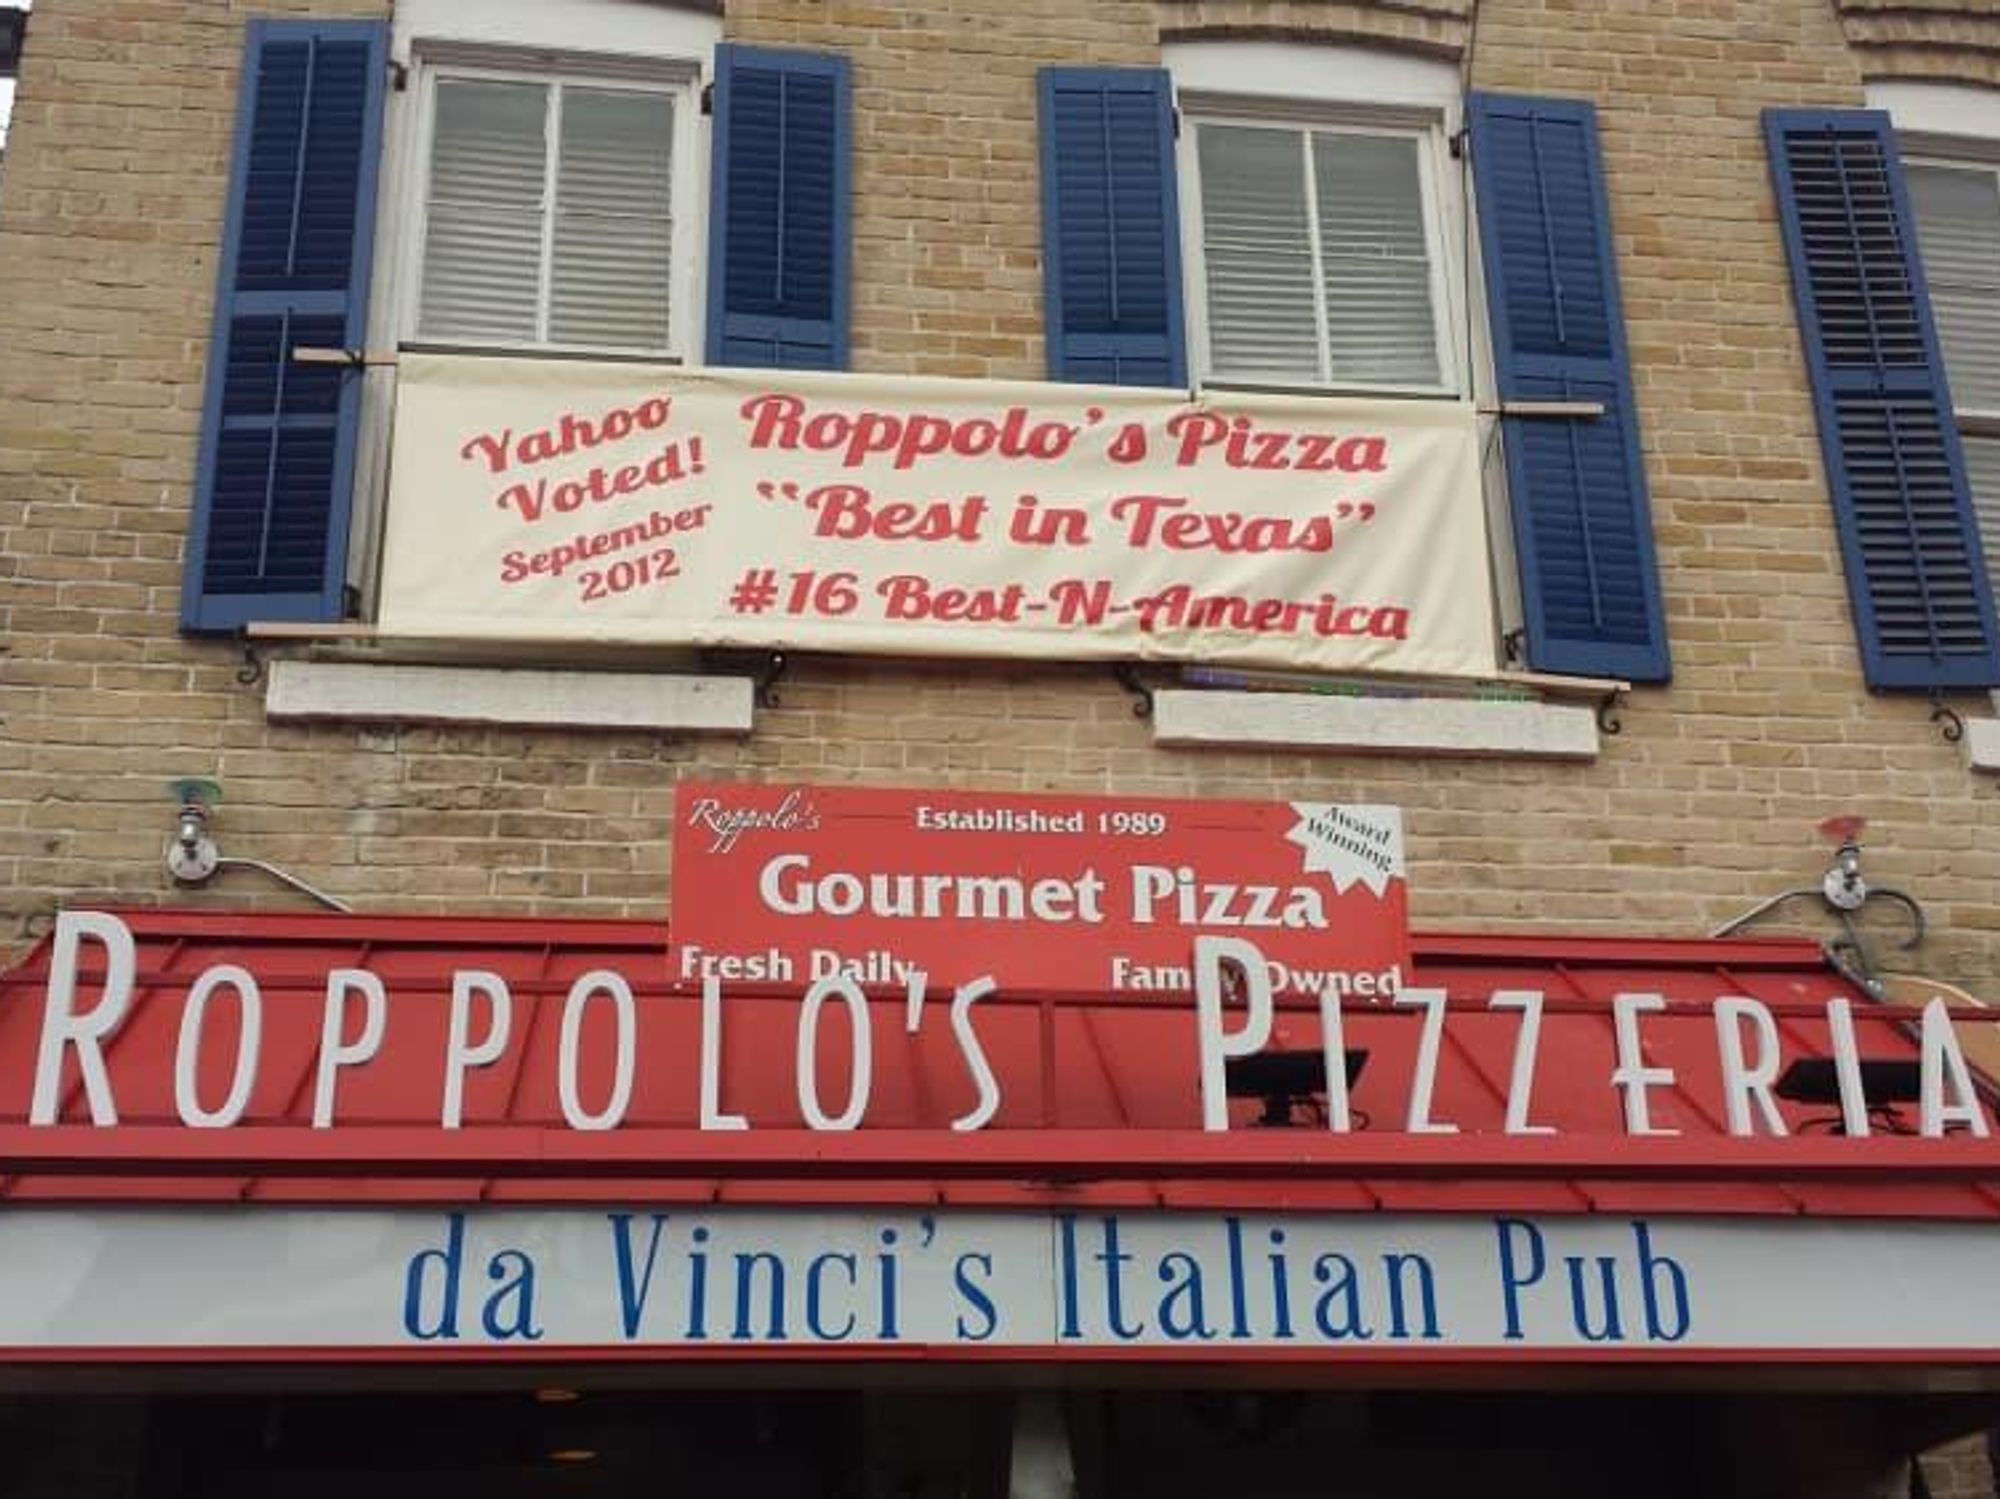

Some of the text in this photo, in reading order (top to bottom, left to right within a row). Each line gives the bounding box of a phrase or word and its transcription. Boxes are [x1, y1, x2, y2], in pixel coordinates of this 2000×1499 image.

[461, 395, 672, 473] Yahoo
[740, 393, 1388, 473] Roppolo's Pizza
[496, 437, 706, 522] Voted!
[756, 480, 1376, 553] "Best in Texas"
[499, 502, 713, 583] September
[579, 547, 681, 602] 2012
[729, 569, 1411, 640] #16 Best-N-America
[915, 806, 1083, 833] Established
[1098, 811, 1168, 837] 1989
[1306, 816, 1395, 873] Winning
[1325, 805, 1393, 847] Award
[758, 853, 1330, 929] Gourmet Pizza
[680, 945, 793, 982] Fresh
[29, 910, 1992, 1138] ROPPOLO'S PIZZERIA
[403, 1213, 1692, 1342] da Vinci's Italian Pub
